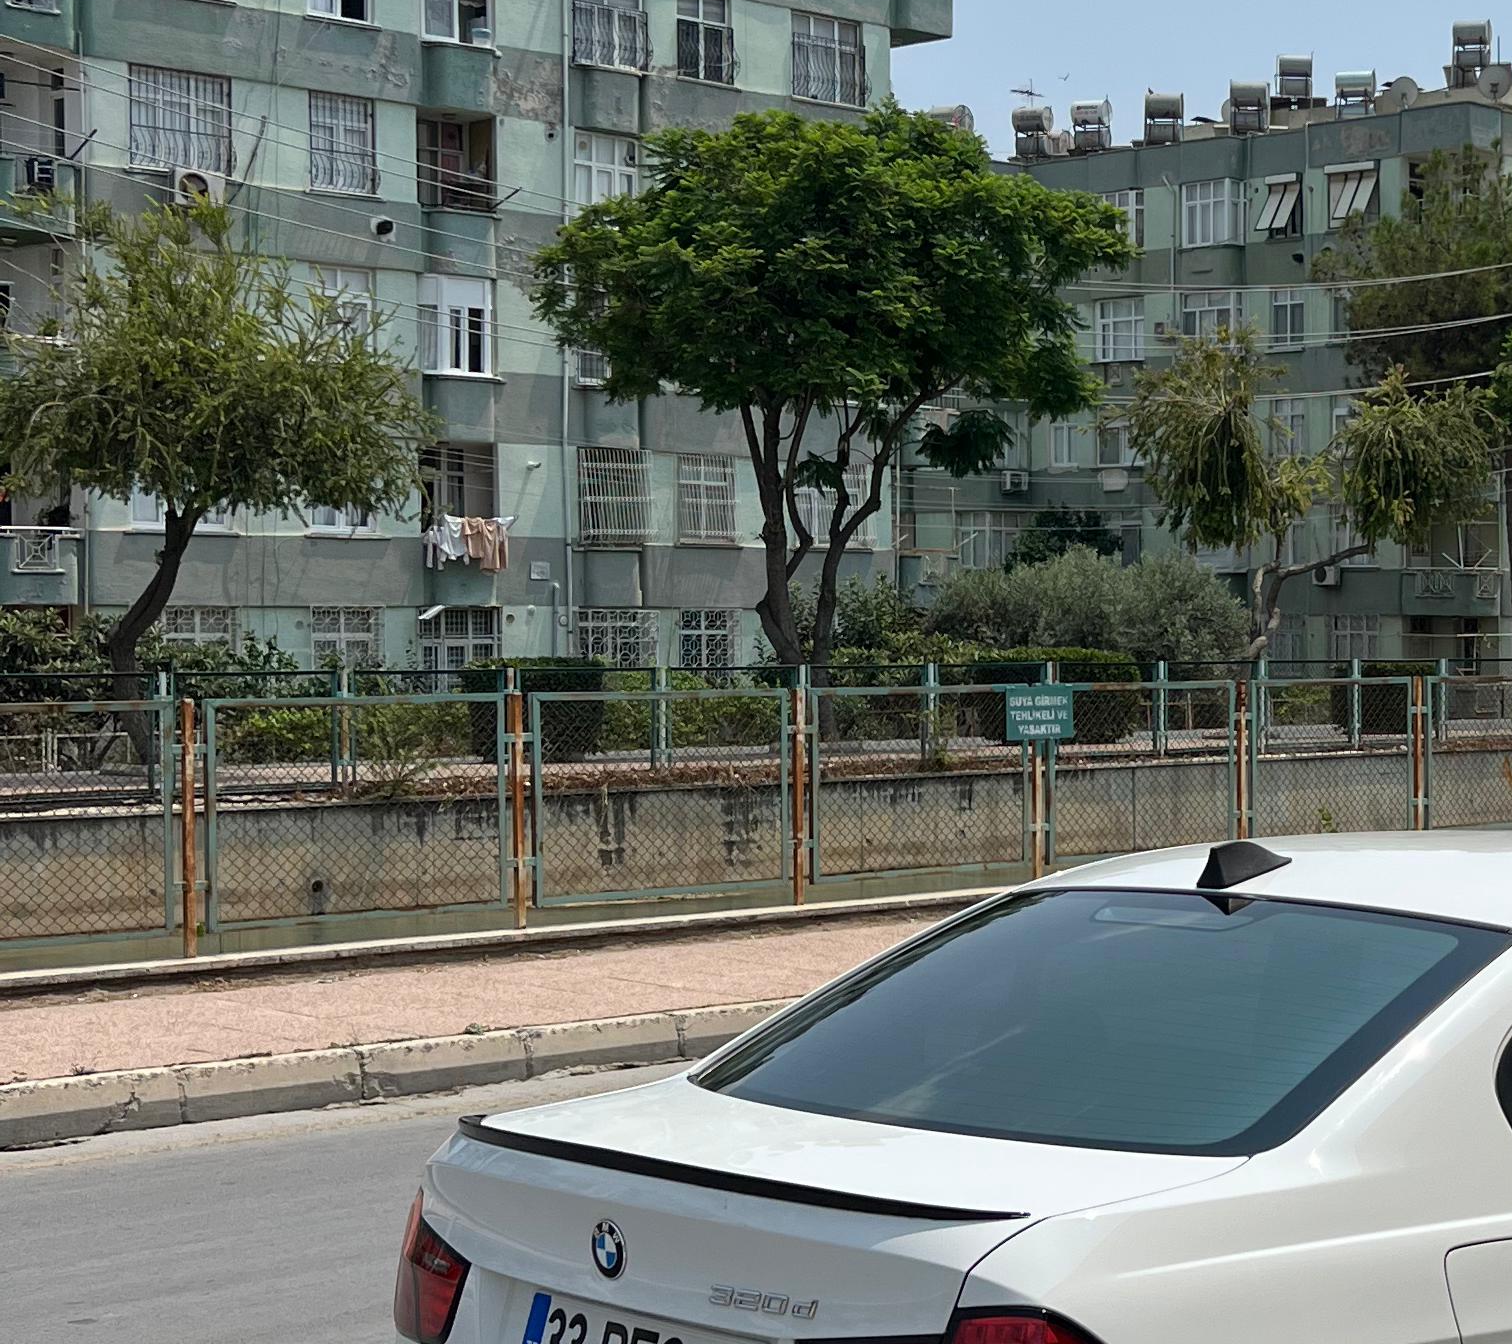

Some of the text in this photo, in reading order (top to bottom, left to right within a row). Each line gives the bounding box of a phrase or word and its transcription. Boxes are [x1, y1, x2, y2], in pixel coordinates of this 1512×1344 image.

[1009, 693, 1068, 707] SUYA GİRMEK
[1010, 707, 1068, 721] TEHLİKELİ VE
[1018, 723, 1061, 735] YASAKTIR
